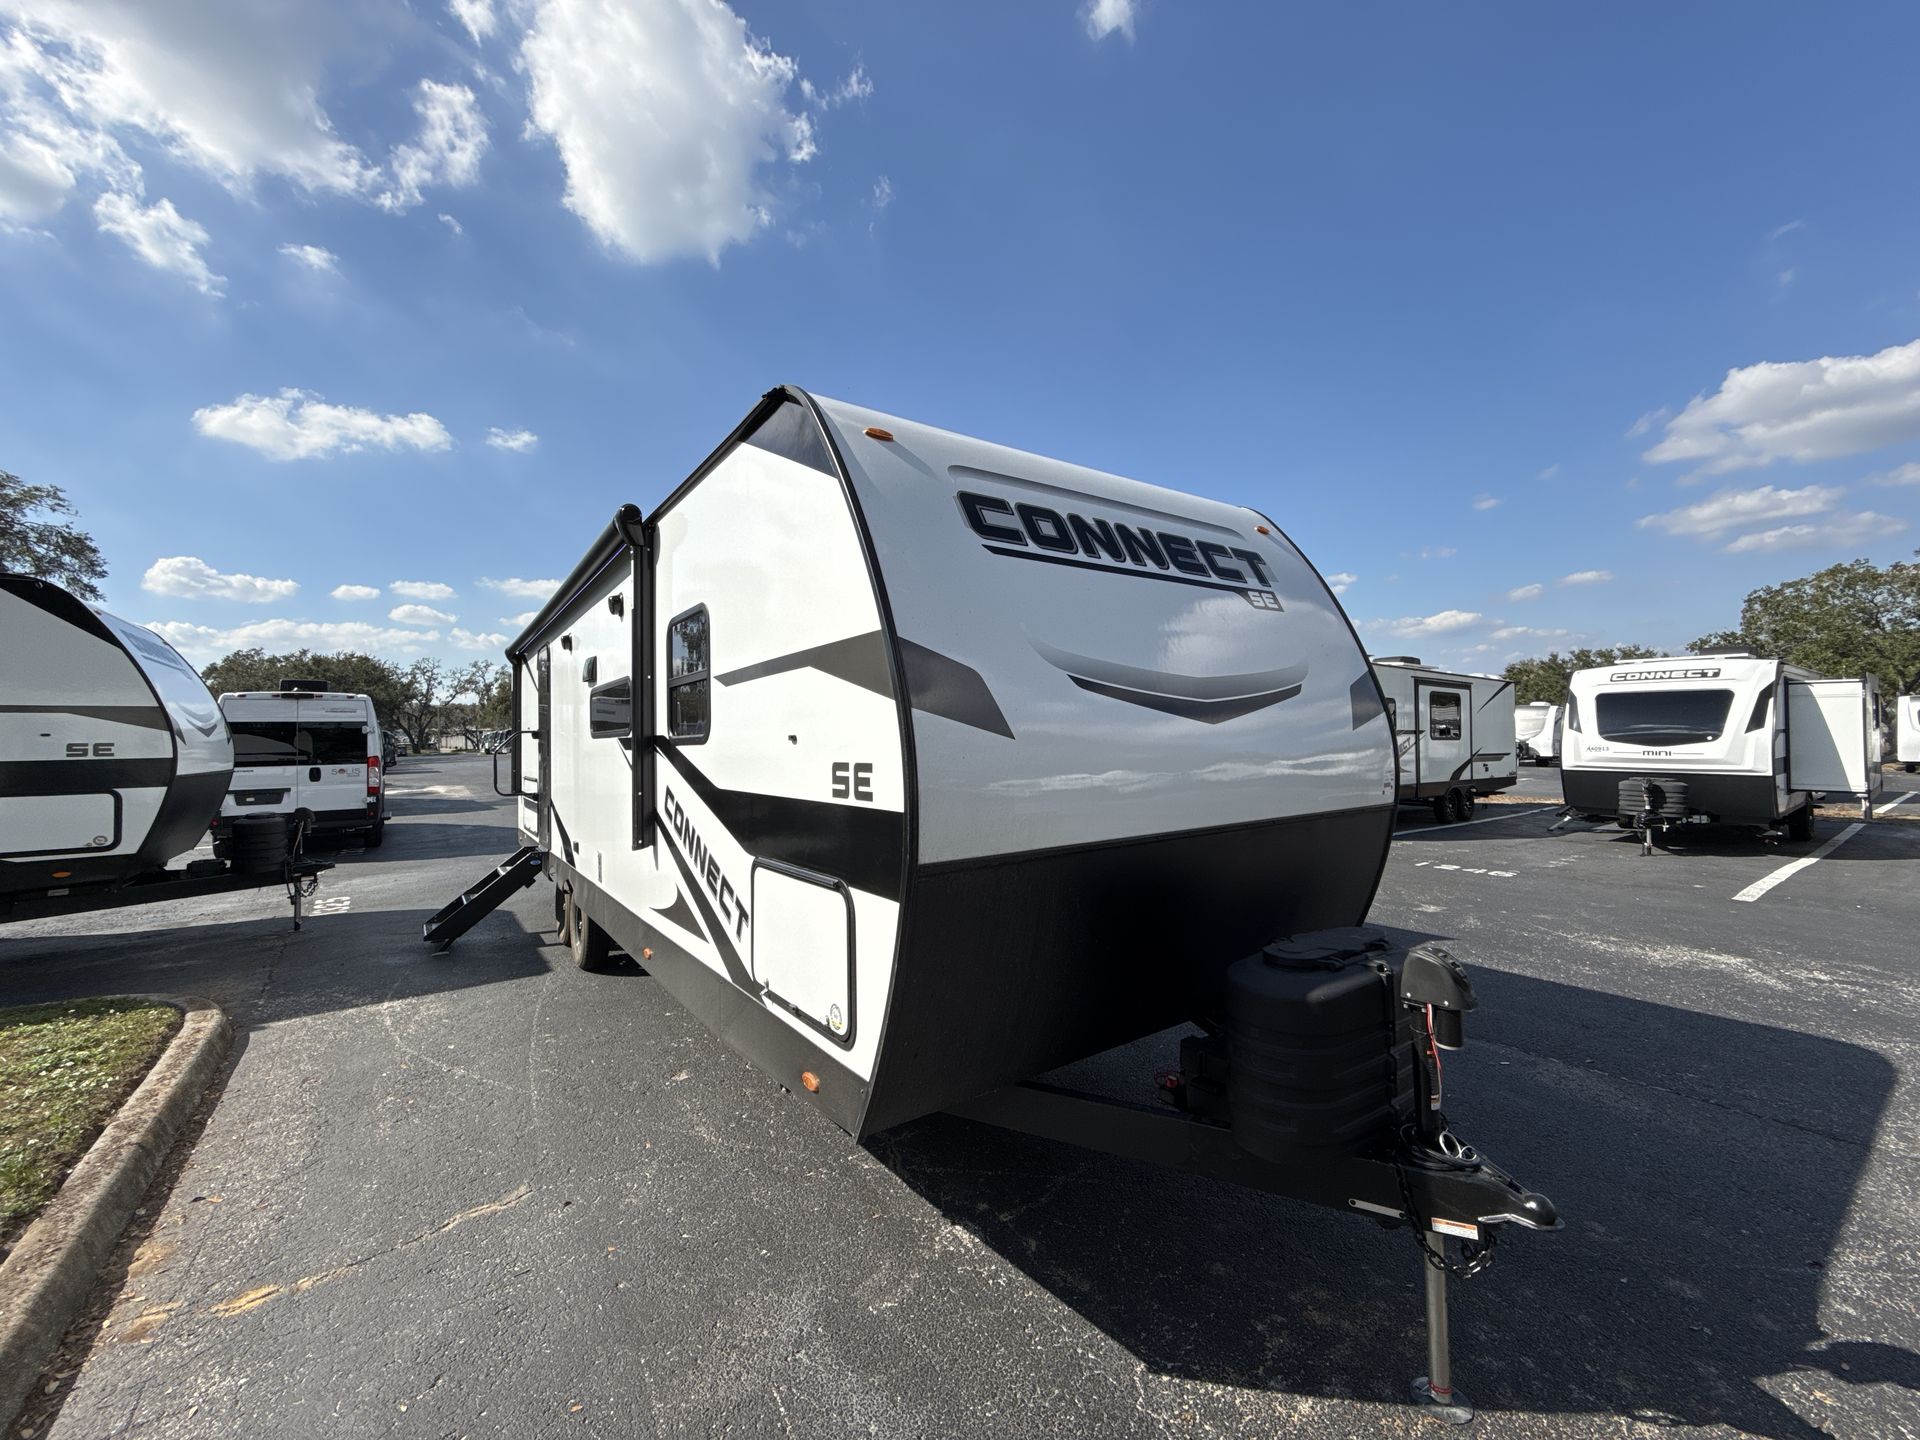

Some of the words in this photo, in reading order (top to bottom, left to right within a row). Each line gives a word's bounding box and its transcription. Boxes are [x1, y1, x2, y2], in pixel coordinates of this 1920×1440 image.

[956, 490, 1273, 587] CONNECT
[1247, 590, 1280, 609] SE
[1611, 669, 1720, 682] CONNECT
[66, 742, 115, 758] SE
[831, 761, 874, 803] SE
[664, 785, 750, 943] CONNECT
